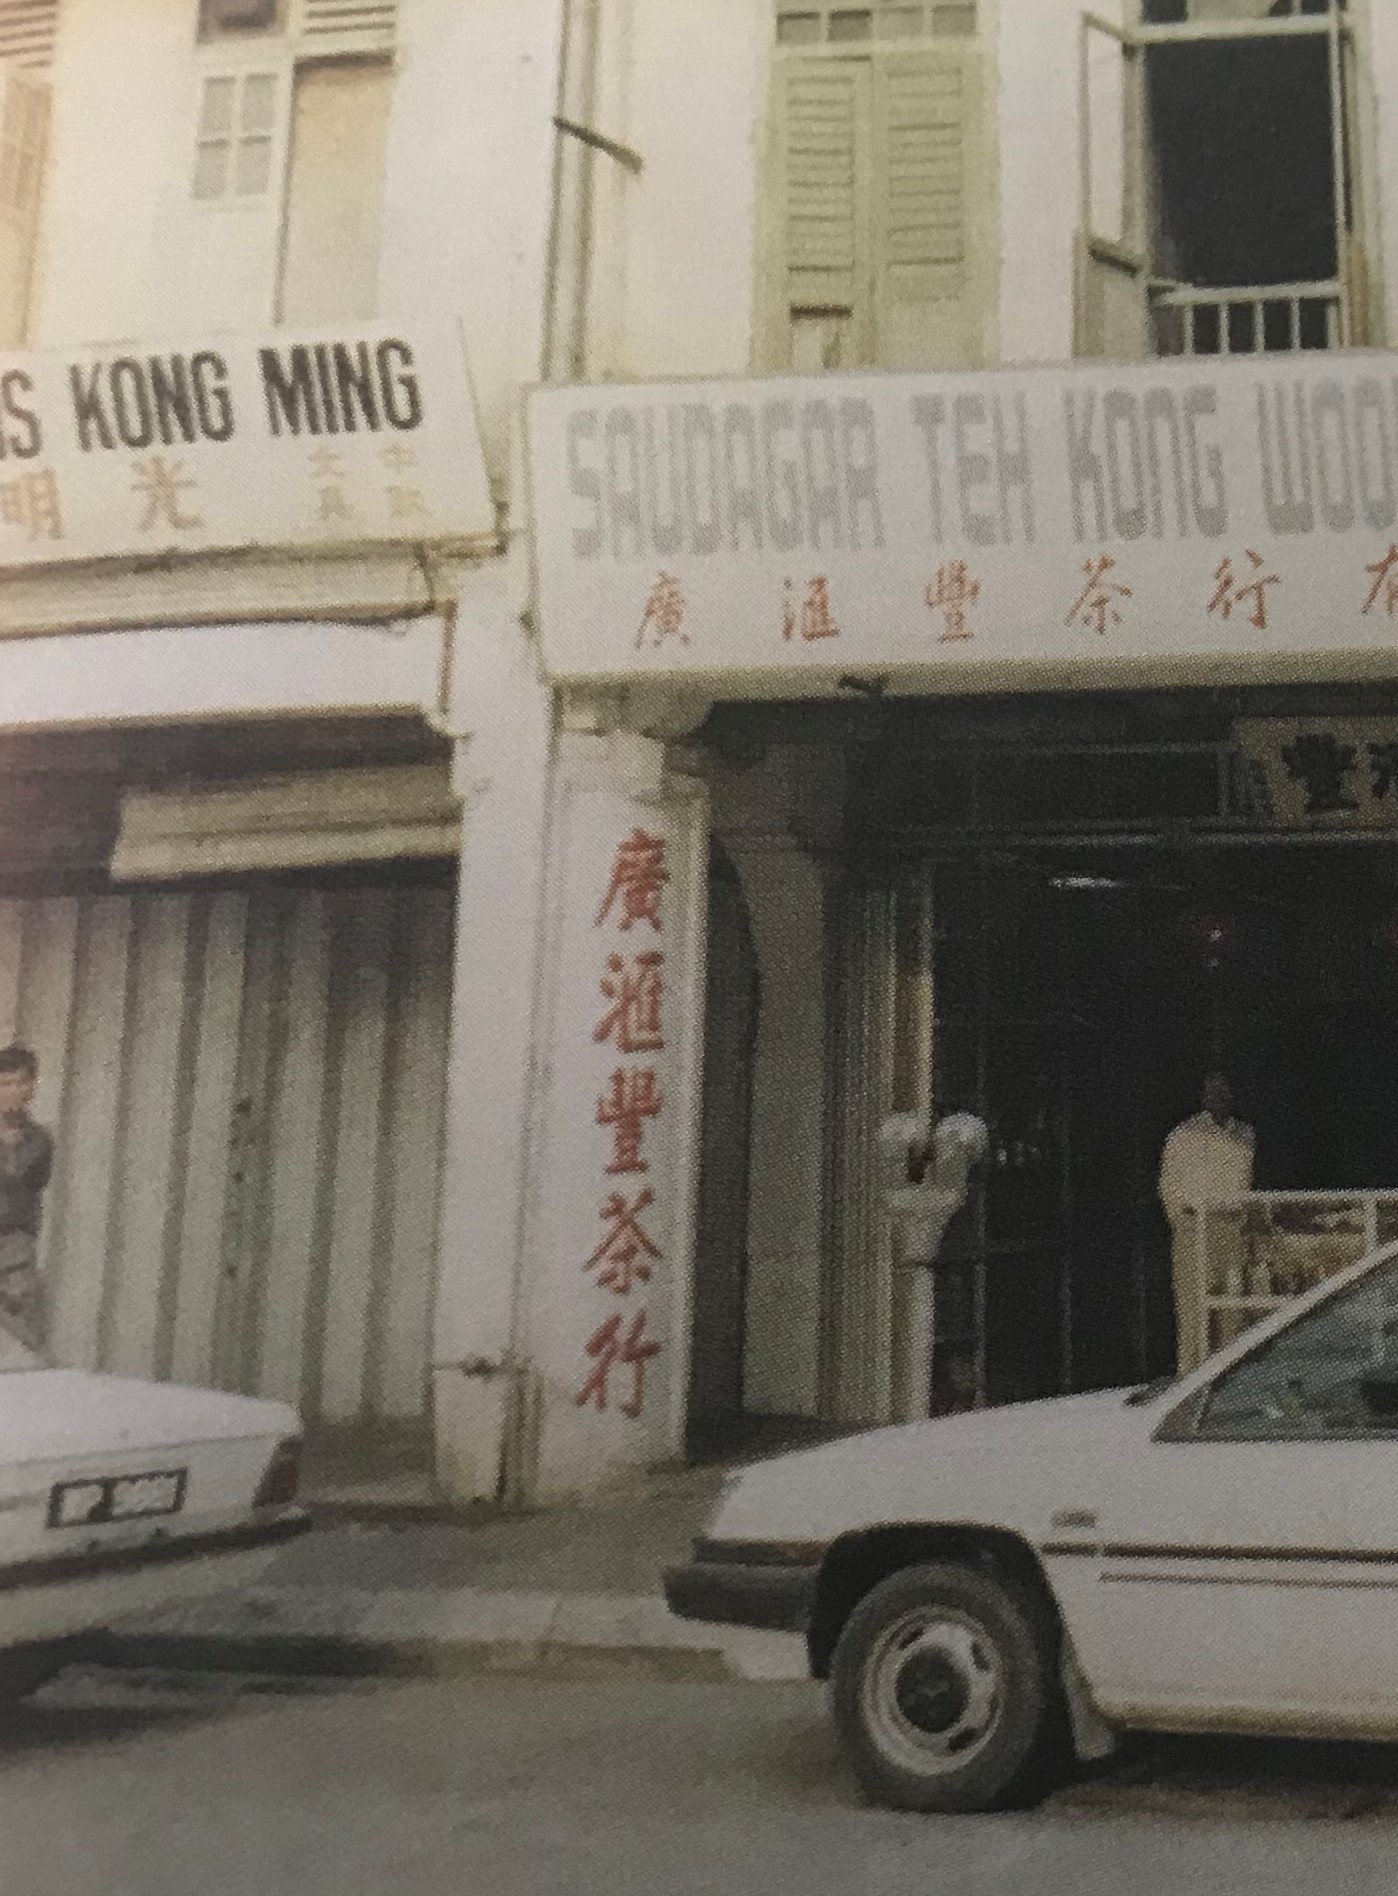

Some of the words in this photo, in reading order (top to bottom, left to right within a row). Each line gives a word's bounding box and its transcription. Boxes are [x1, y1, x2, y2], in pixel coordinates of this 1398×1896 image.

[69, 350, 236, 453] KONG
[259, 338, 424, 437] MING
[1061, 384, 1230, 546] KONG
